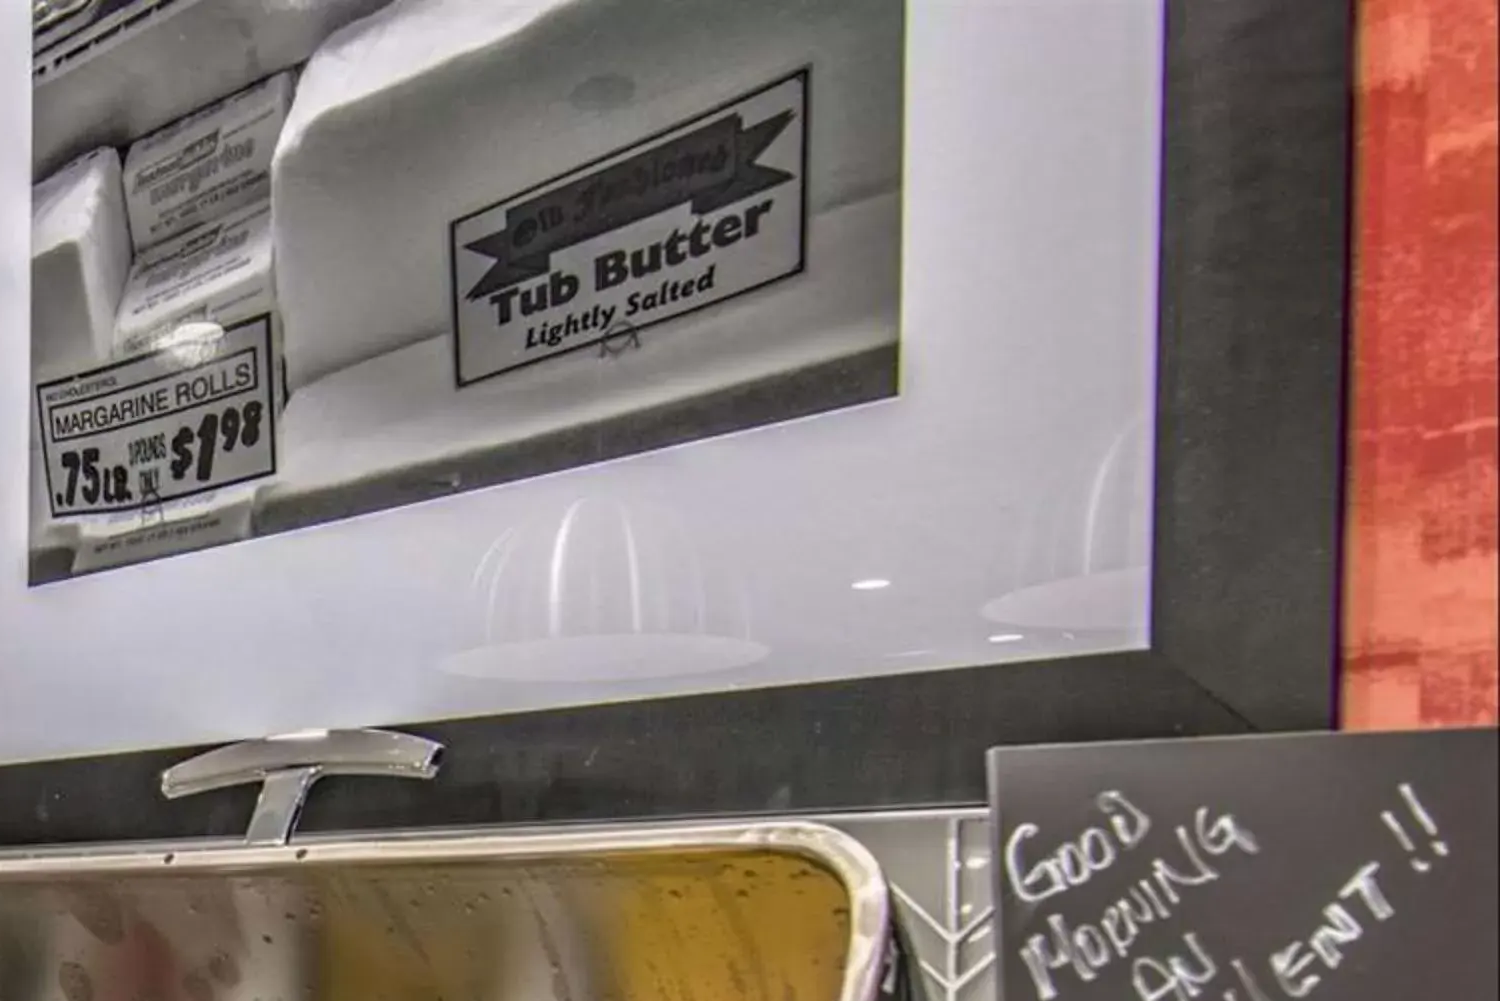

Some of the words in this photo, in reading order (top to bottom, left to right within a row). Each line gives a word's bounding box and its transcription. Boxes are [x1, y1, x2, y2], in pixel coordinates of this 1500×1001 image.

[489, 270, 579, 326] Tub
[594, 200, 774, 291] Butter
[525, 304, 617, 349] Lightly
[625, 264, 716, 317] Salted
[55, 393, 170, 435] MARGARINE
[176, 363, 252, 405] ROLLS
[56, 447, 100, 507] .75
[1020, 806, 1260, 1001] MORNING
